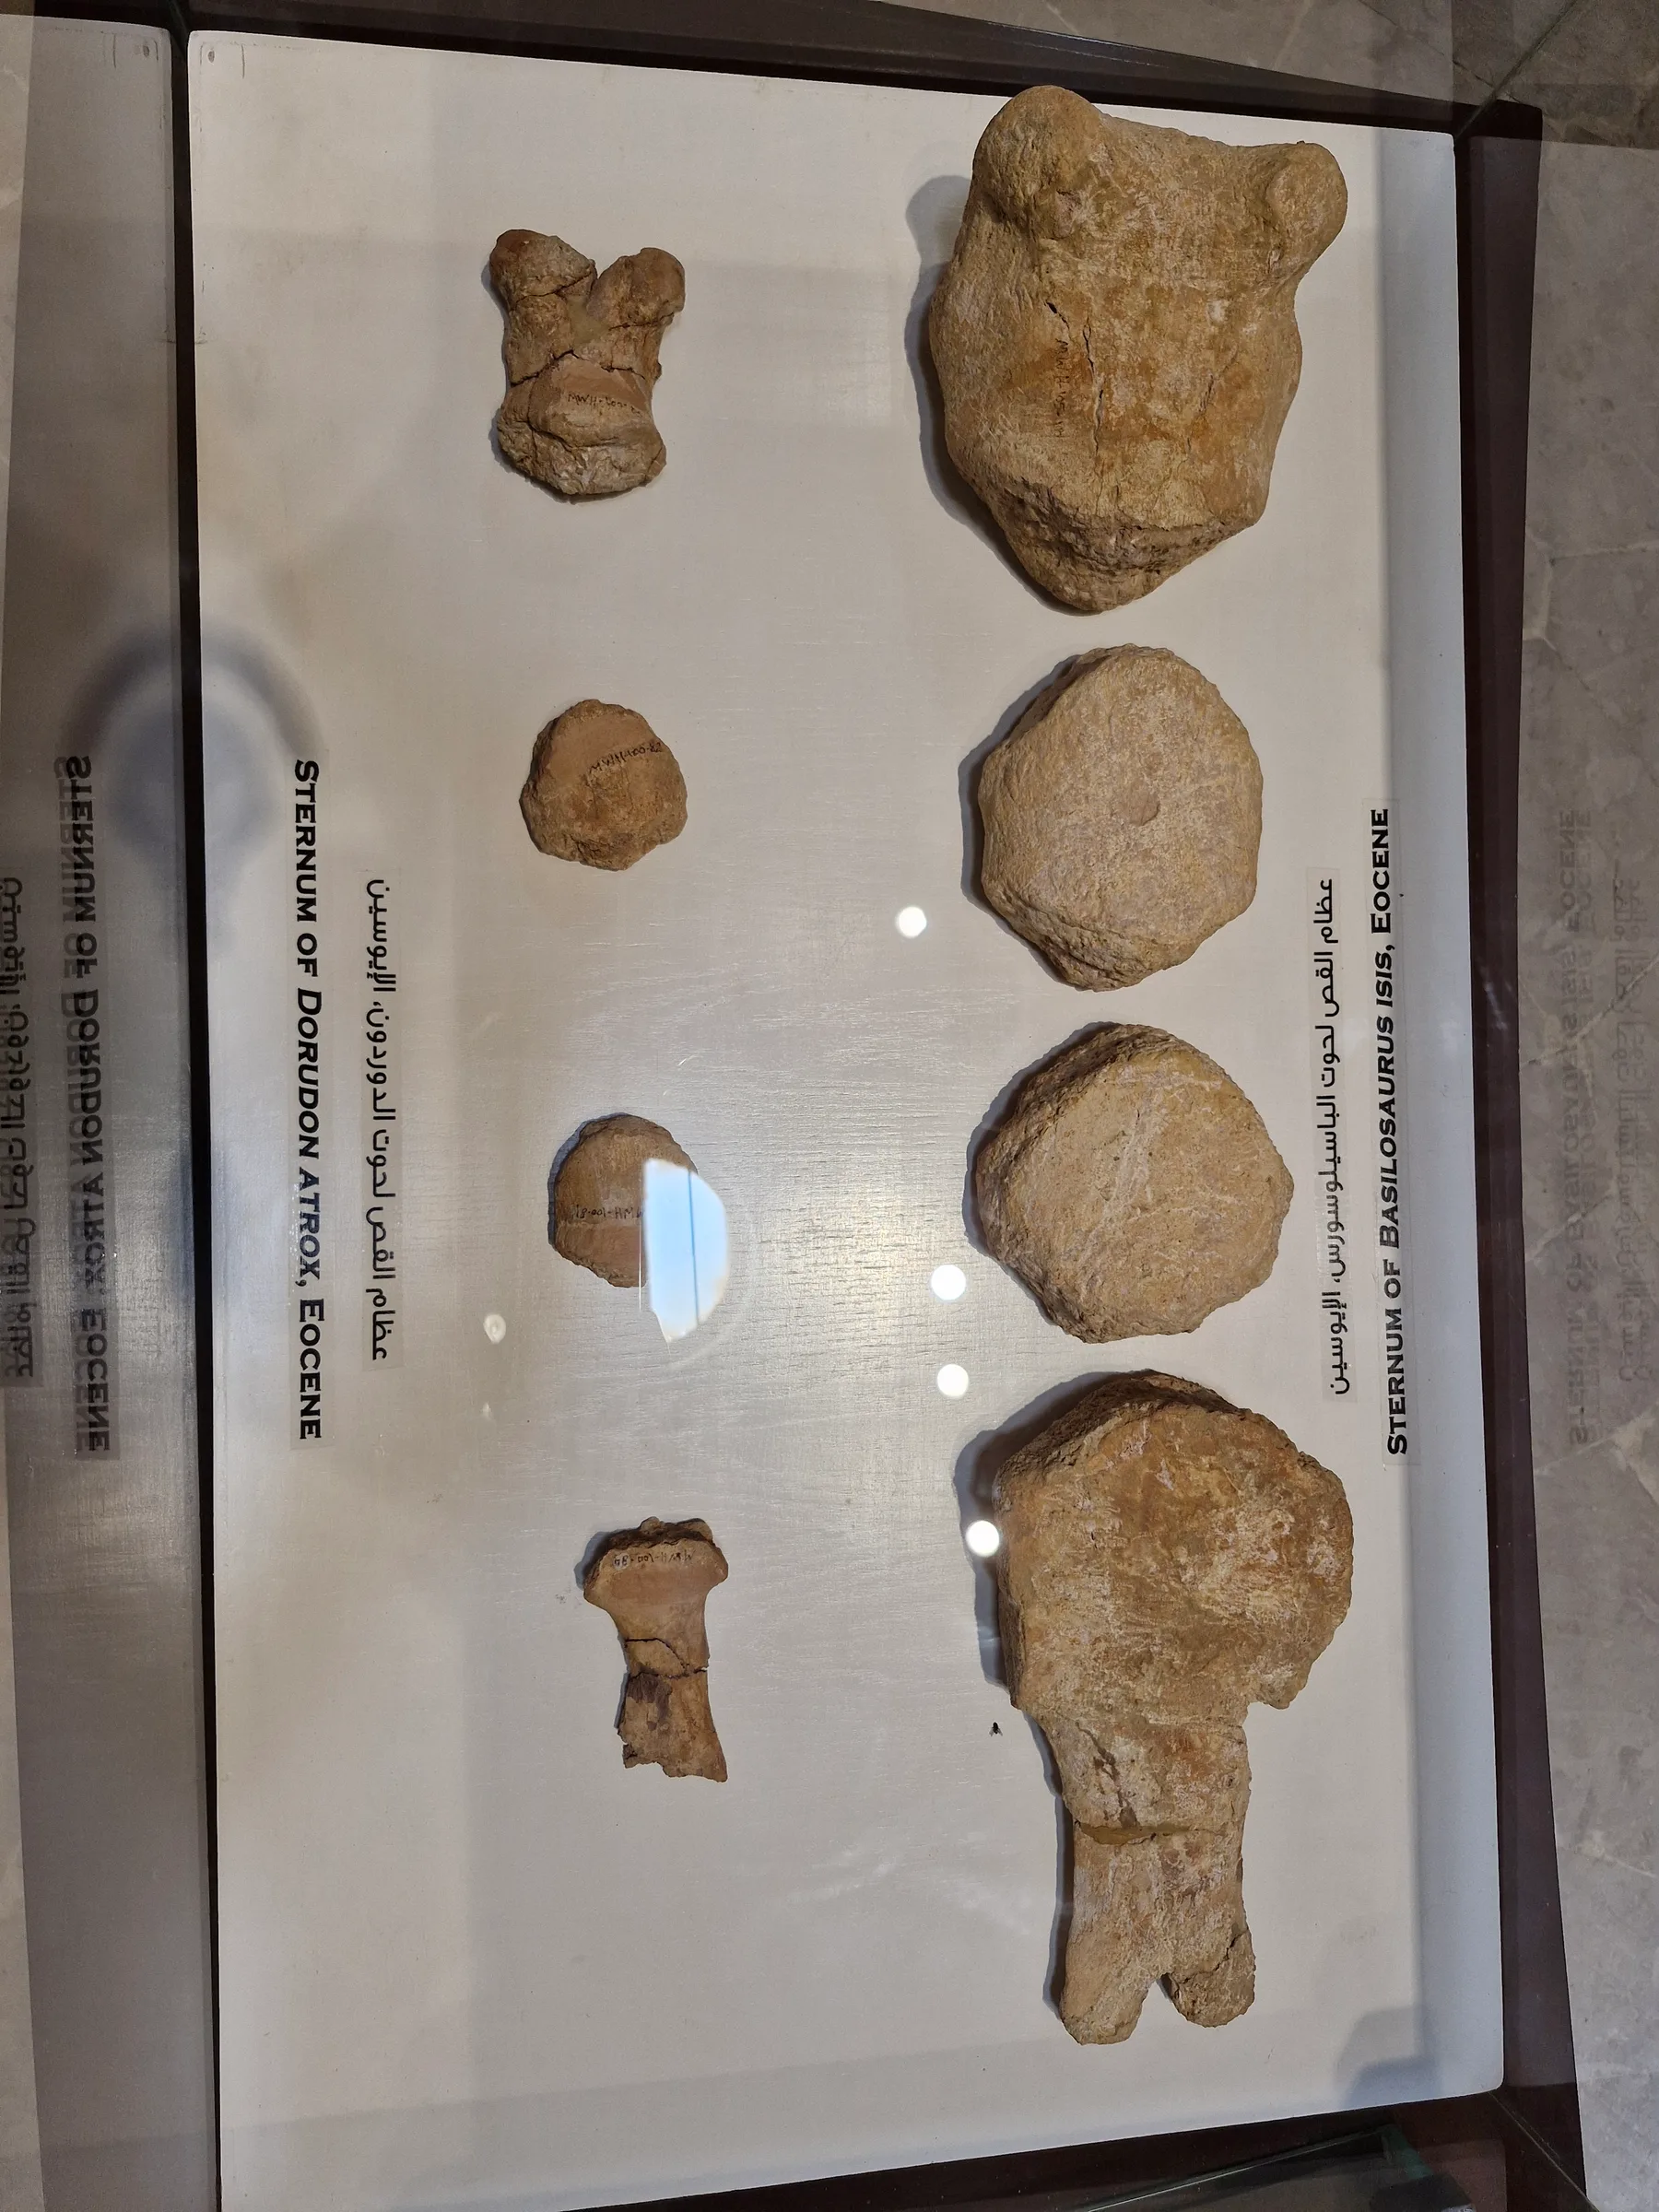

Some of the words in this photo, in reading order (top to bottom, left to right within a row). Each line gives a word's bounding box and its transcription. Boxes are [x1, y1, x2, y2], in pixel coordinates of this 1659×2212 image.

[295, 759, 320, 923] STERNUM
[1370, 809, 1390, 934] EOCENE
[297, 933, 319, 977] OF
[366, 879, 396, 992] الإيوسين
[1313, 878, 1338, 944] عظام
[1313, 951, 1340, 1018] القص
[1374, 945, 1395, 1007] ISIS,
[297, 987, 322, 1159] DORUDON
[366, 1002, 396, 1120] الدوردون،
[1314, 1025, 1341, 1088] لحوت
[366, 1129, 396, 1197] لحوت
[1376, 1015, 1399, 1249] BASILOSAURUS
[295, 1167, 323, 1287] ATROX,
[366, 1206, 396, 1279] القص
[1316, 1095, 1347, 1283] الباسيلوسورس،
[366, 1288, 396, 1361] عظام
[1382, 1259, 1402, 1299] OF
[299, 1299, 324, 1440] EOCENE
[1322, 1291, 1351, 1394] الإيوسين
[1385, 1308, 1407, 1454] STERNUM
